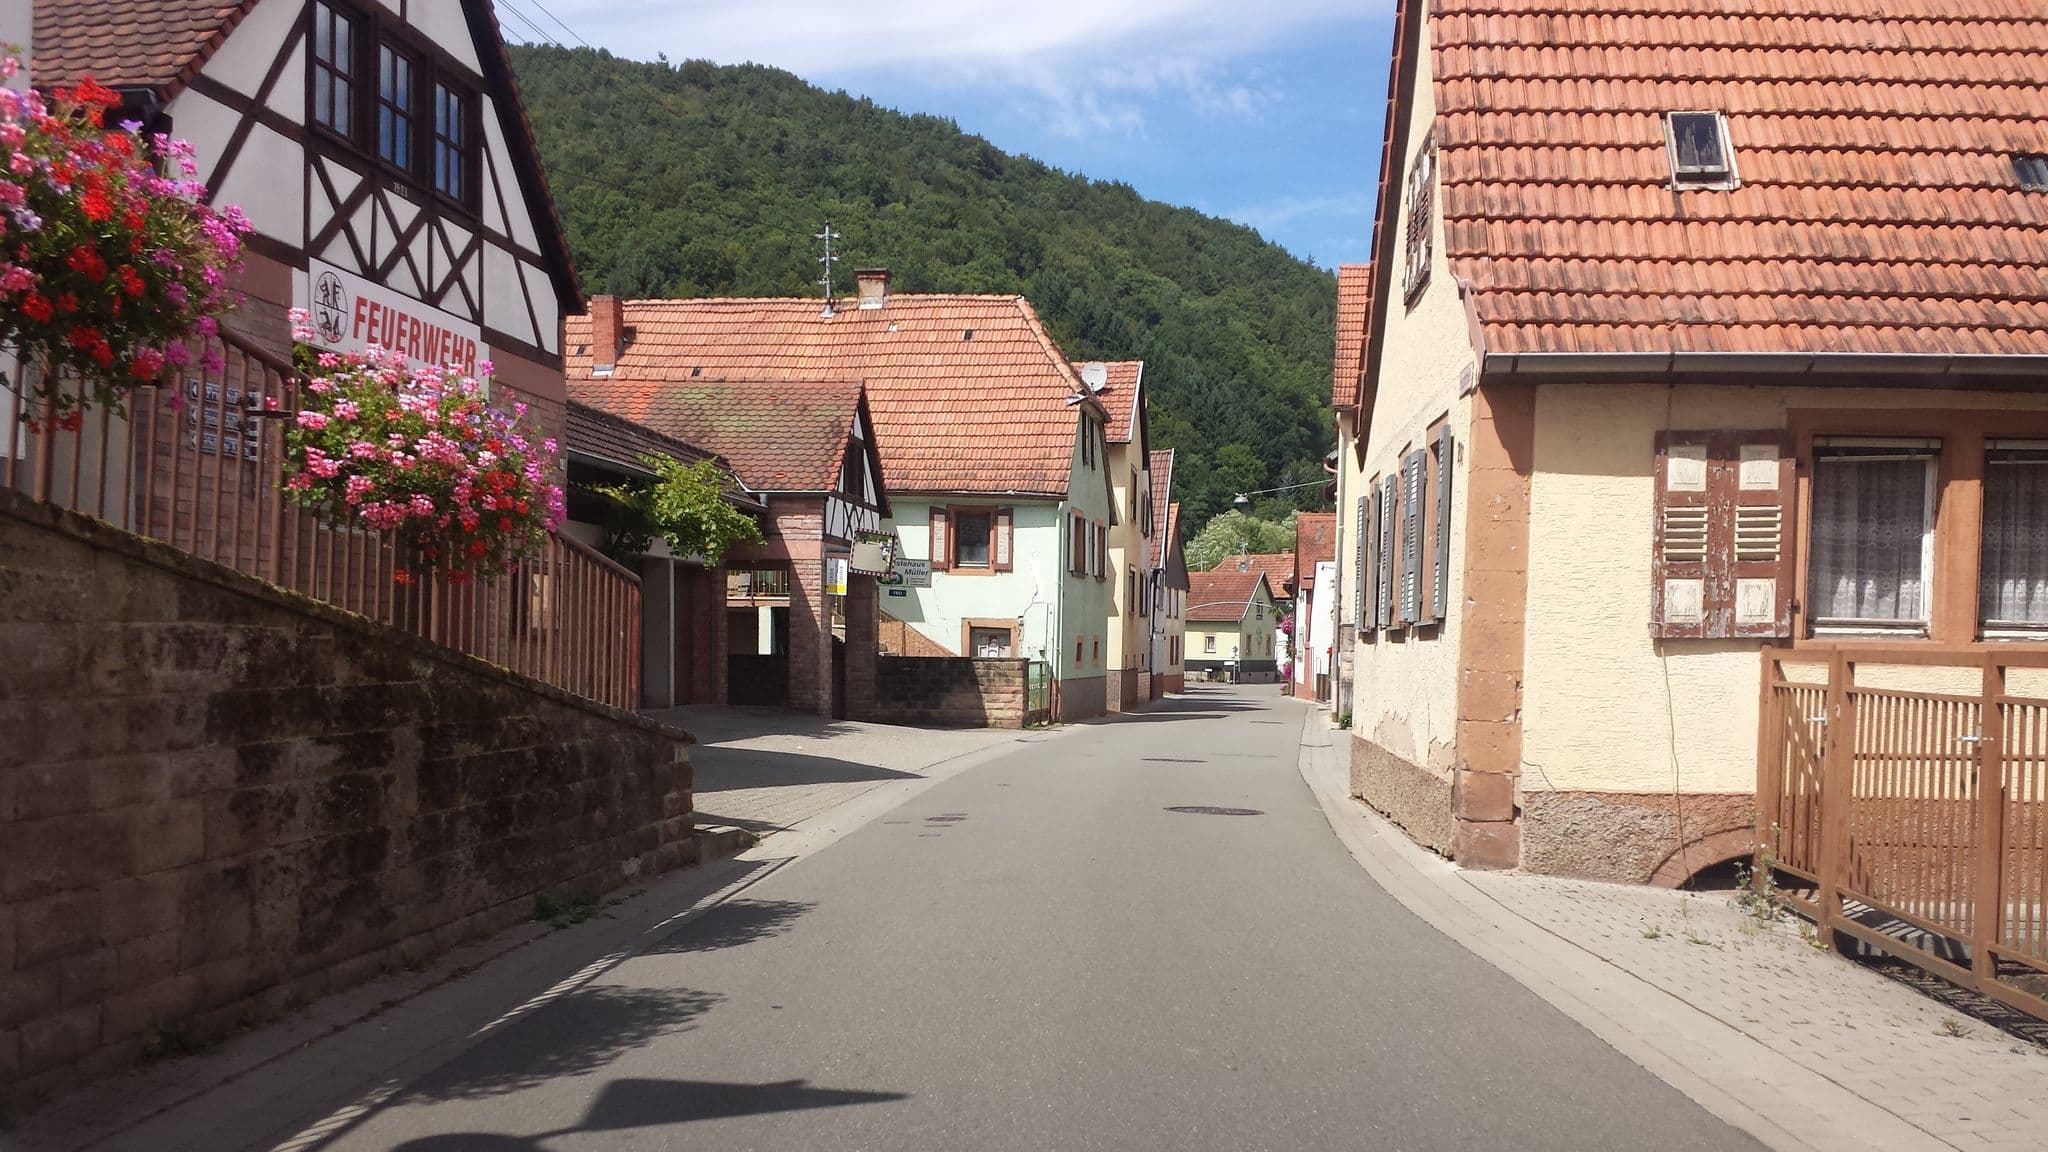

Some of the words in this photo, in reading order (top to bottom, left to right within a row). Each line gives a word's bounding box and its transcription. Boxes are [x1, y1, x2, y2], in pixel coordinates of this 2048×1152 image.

[353, 295, 477, 378] FEUERWEHR
[896, 560, 926, 568] stehaus
[904, 568, 929, 576] Müller
